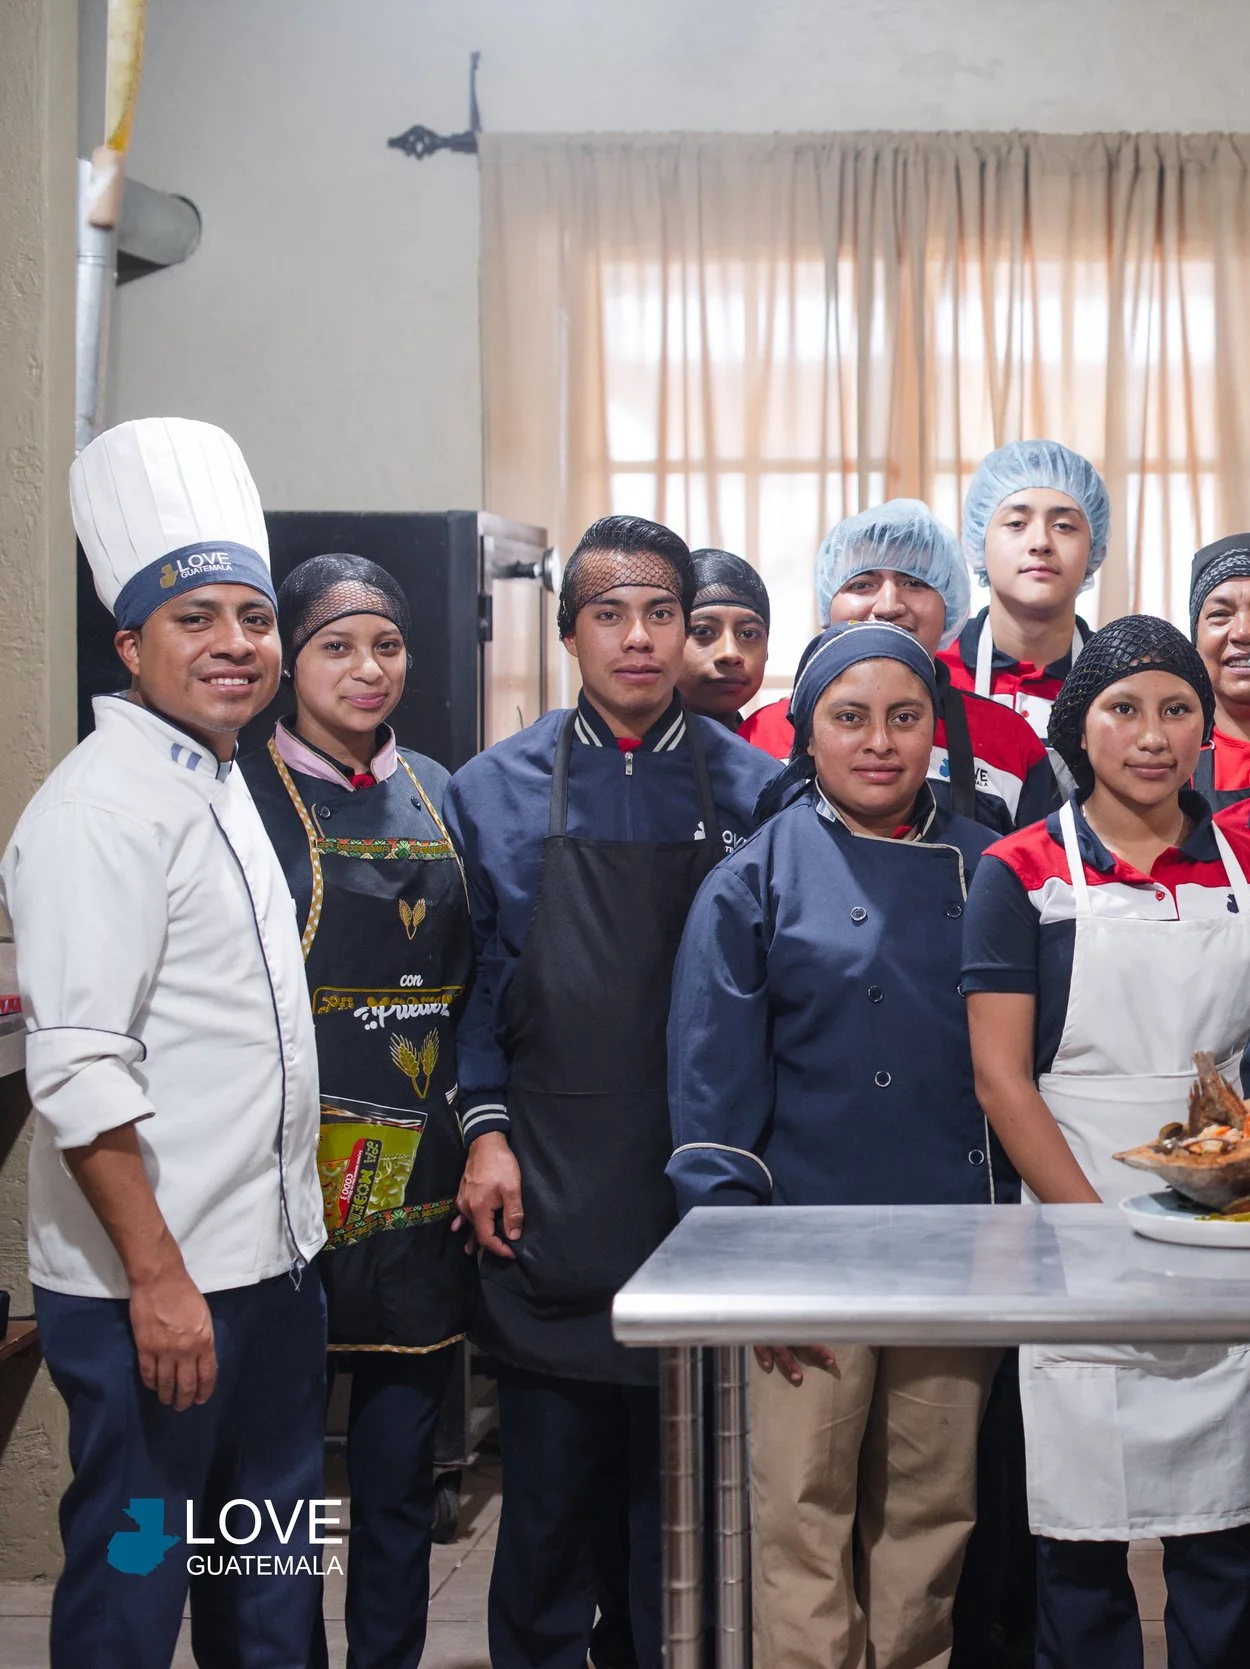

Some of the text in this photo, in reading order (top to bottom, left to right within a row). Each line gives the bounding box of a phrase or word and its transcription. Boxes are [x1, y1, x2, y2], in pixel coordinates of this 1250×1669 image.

[176, 552, 231, 573] LOVE
[181, 565, 233, 578] GUATEMALA
[400, 974, 423, 987] con
[342, 1174, 353, 1194] CODO
